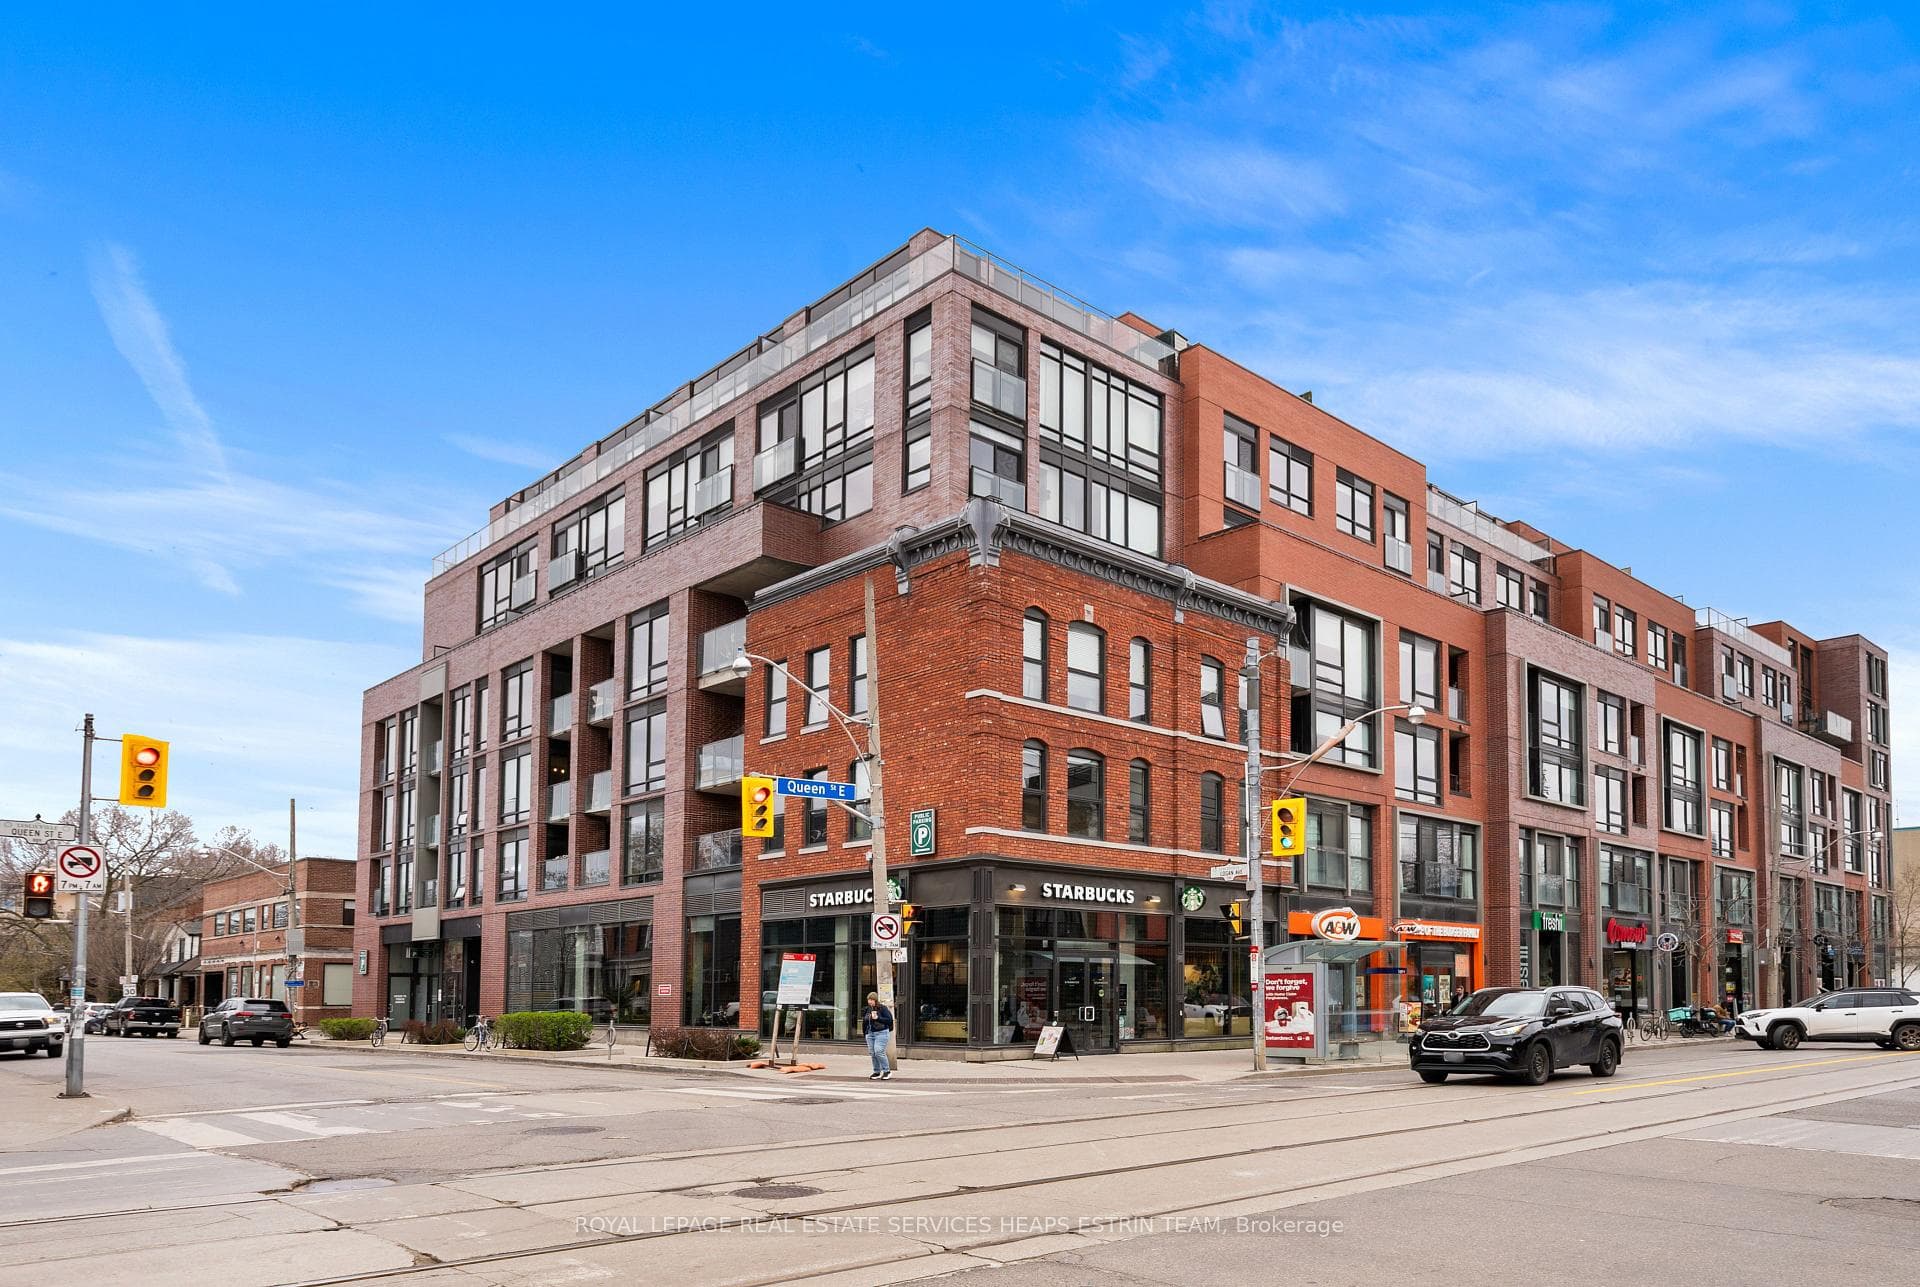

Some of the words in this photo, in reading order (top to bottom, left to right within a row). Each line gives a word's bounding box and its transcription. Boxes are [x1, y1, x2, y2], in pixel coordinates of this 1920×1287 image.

[787, 781, 826, 795] Queen
[839, 786, 846, 797] E
[913, 817, 932, 825] PARKING
[11, 828, 40, 837] QUEEN
[44, 830, 54, 838] ST
[58, 831, 63, 839] E
[61, 881, 67, 889] 7
[1043, 882, 1135, 904] STARBUCKS
[1324, 920, 1357, 935] A&W
[124, 988, 136, 996] 30
